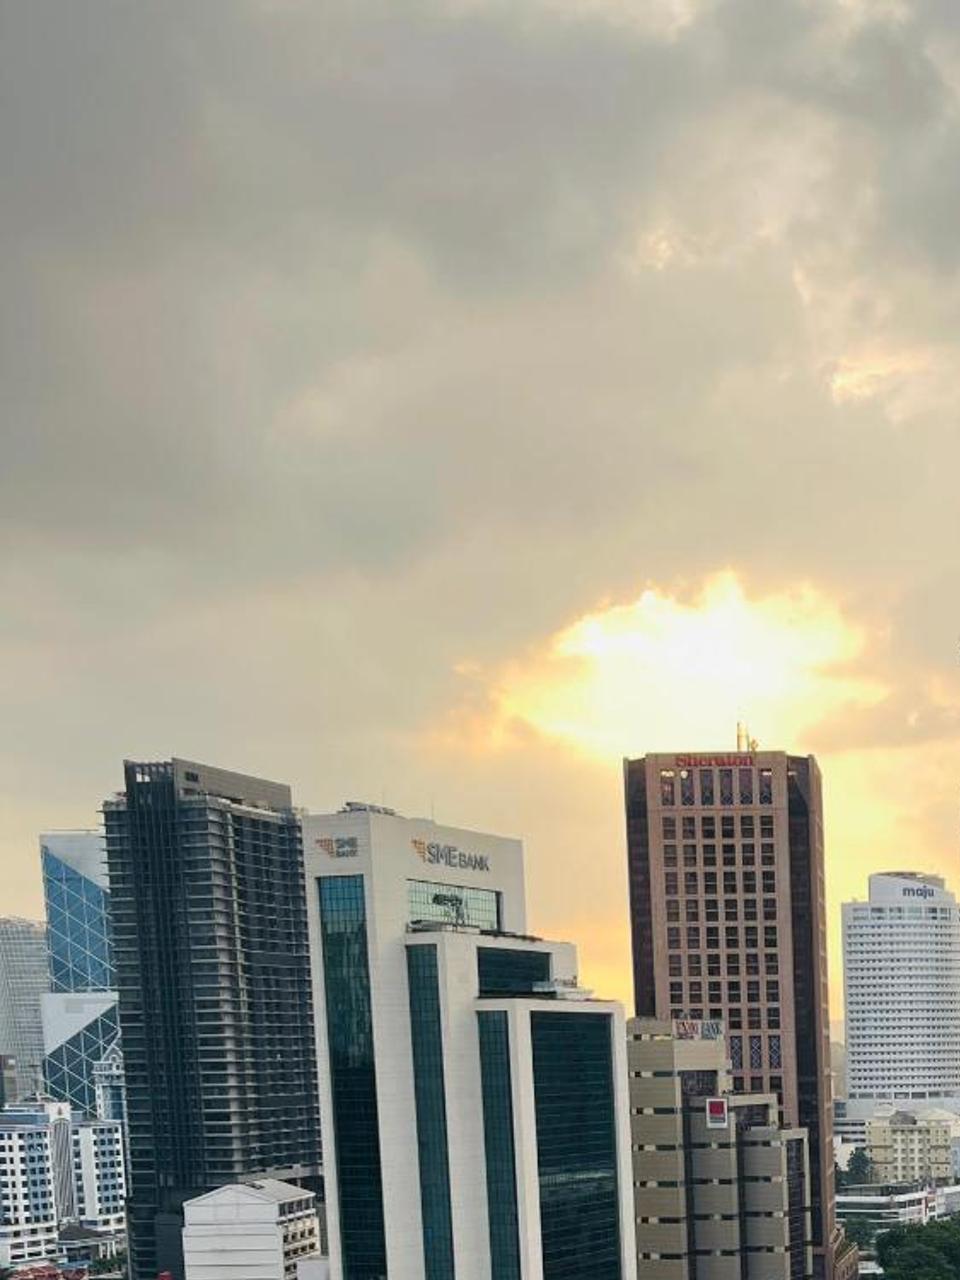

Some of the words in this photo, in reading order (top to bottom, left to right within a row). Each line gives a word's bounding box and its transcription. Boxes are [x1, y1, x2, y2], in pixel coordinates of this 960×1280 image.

[427, 842, 458, 867] SME
[459, 851, 490, 872] BANK
[902, 885, 934, 899] maju
